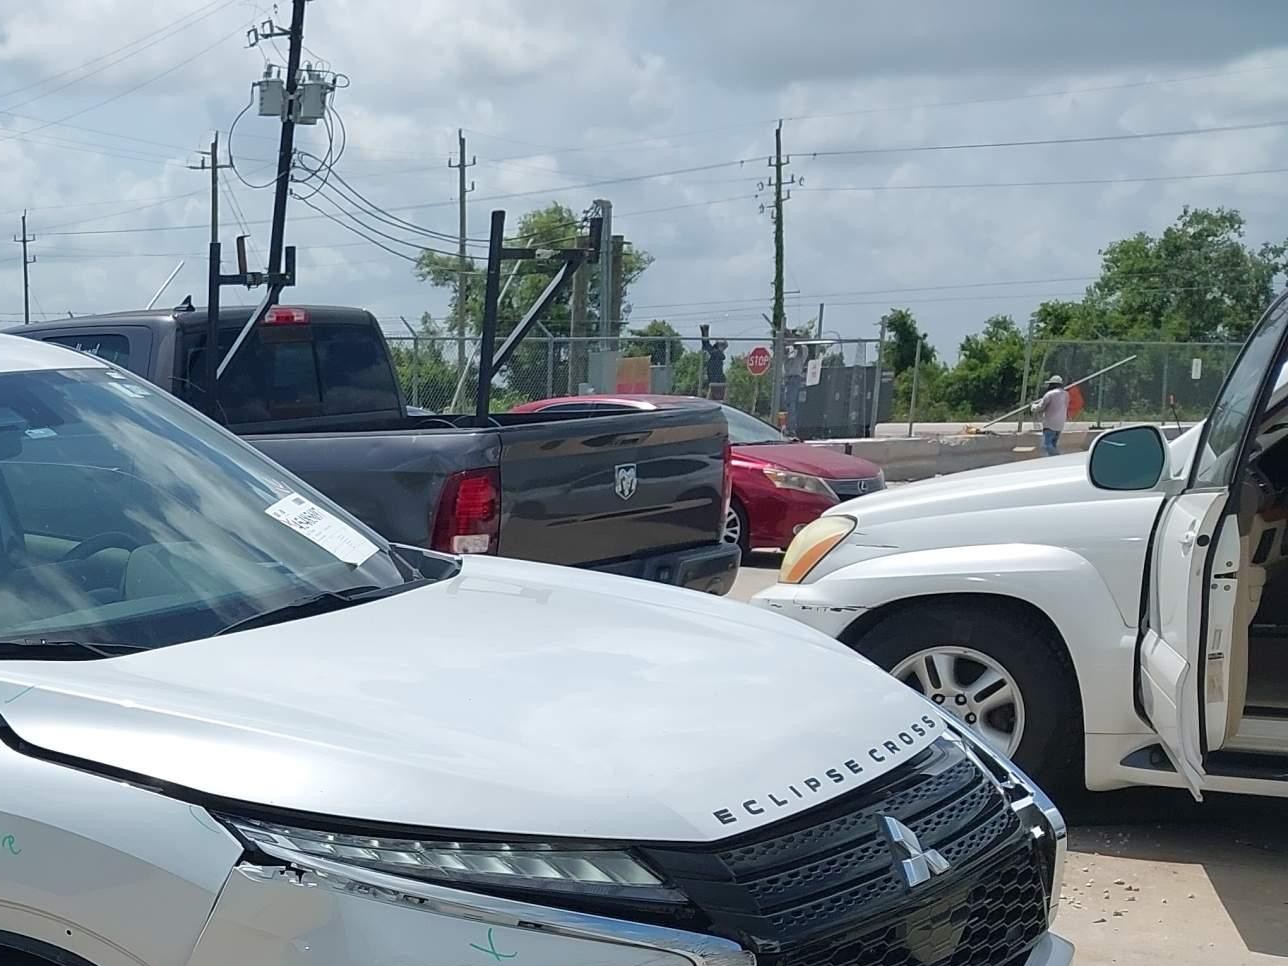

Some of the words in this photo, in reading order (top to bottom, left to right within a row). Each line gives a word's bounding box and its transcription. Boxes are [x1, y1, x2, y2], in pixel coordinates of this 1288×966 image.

[749, 355, 769, 367] STOP
[712, 759, 864, 826] ECLIPSE
[868, 714, 937, 764] CROSS
